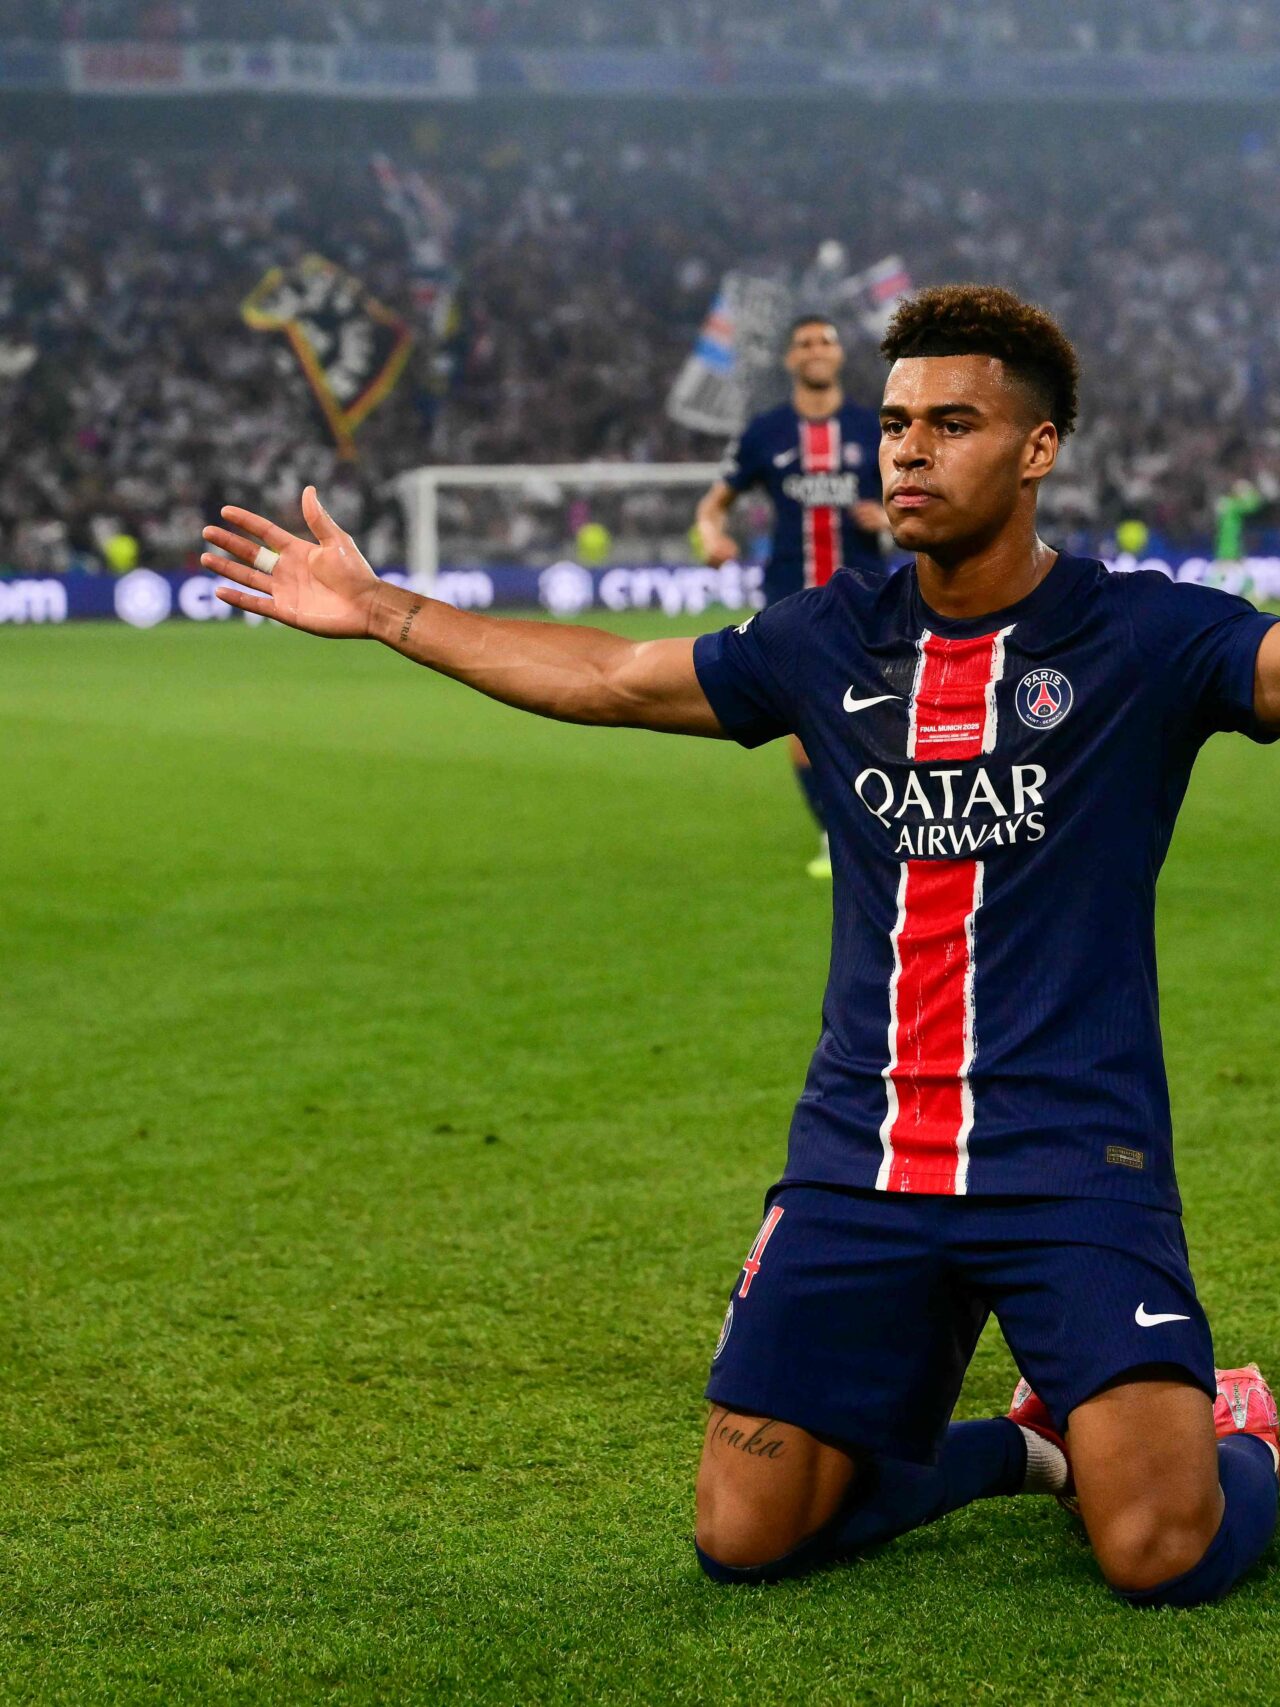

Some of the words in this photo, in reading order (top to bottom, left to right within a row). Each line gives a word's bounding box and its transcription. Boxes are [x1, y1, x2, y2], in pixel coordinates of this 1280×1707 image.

[1023, 671, 1062, 687] PARIS
[855, 764, 1047, 829] QATAR
[894, 812, 1046, 856] AIRWAYS
